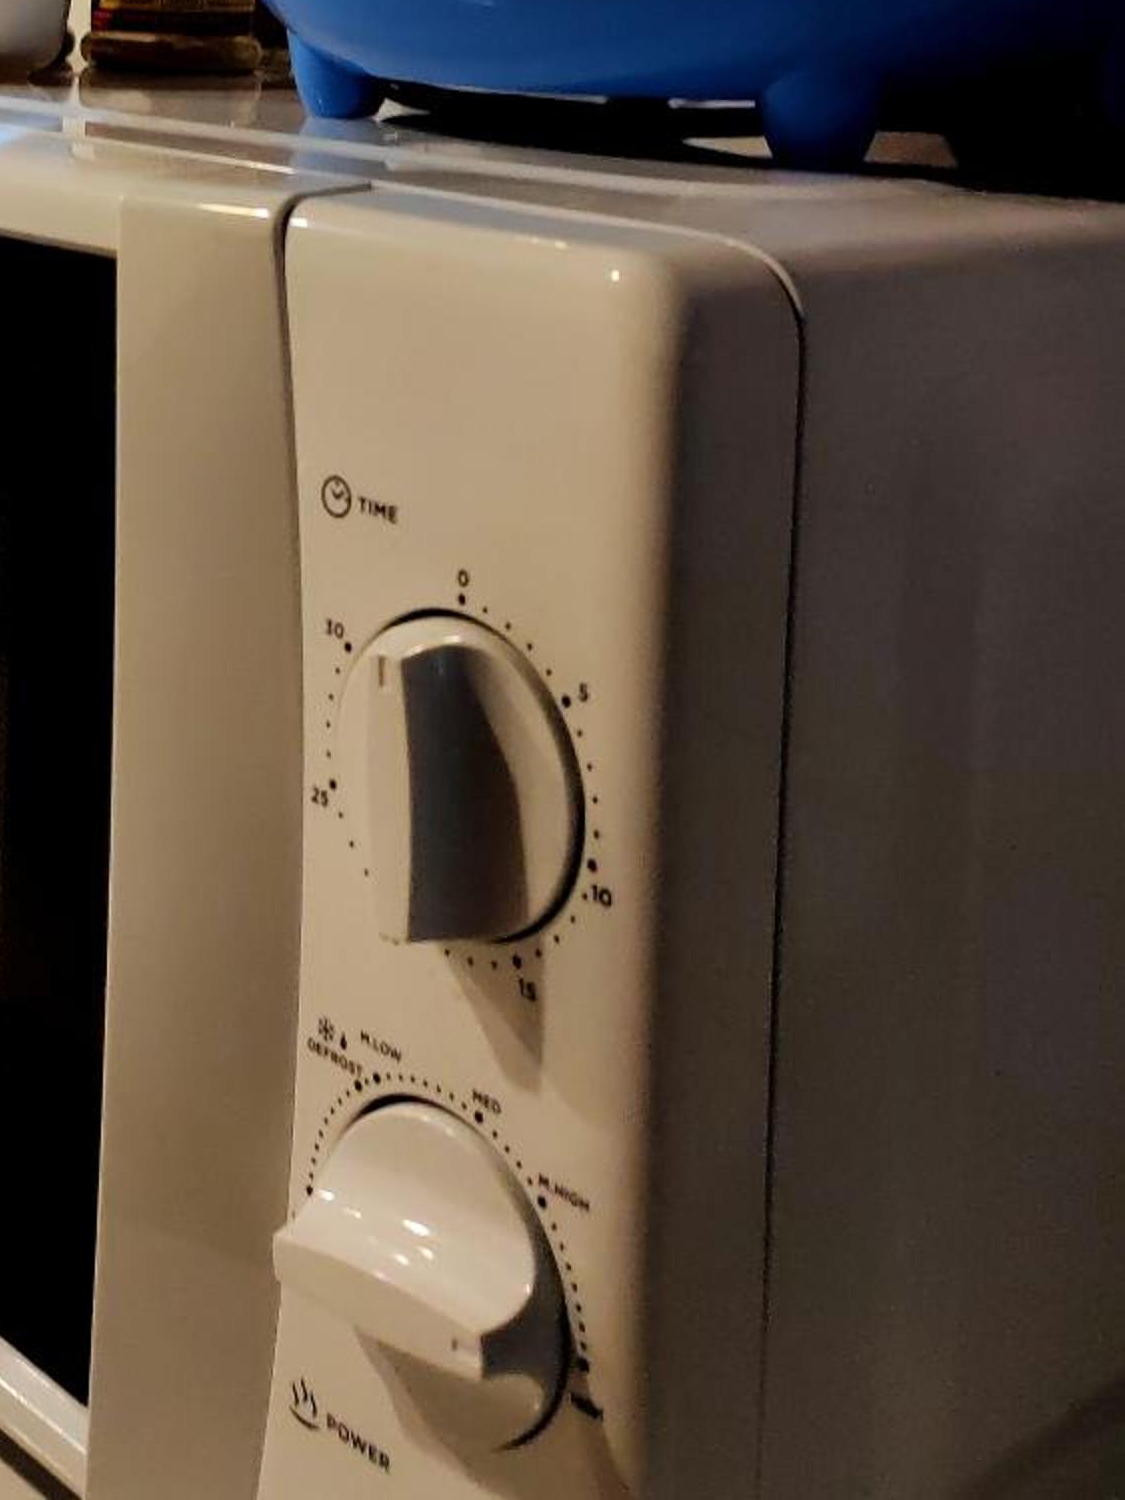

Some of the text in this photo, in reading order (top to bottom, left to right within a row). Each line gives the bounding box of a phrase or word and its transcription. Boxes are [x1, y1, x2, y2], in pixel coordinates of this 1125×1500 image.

[358, 496, 398, 524] TIME
[457, 569, 470, 587] 0
[578, 681, 590, 703] 5
[312, 786, 330, 808] 25
[591, 883, 613, 909] 10
[517, 976, 538, 1003] 15
[306, 1037, 363, 1076] DEFROST
[472, 1088, 502, 1114] MED
[326, 1411, 391, 1474] POWER
